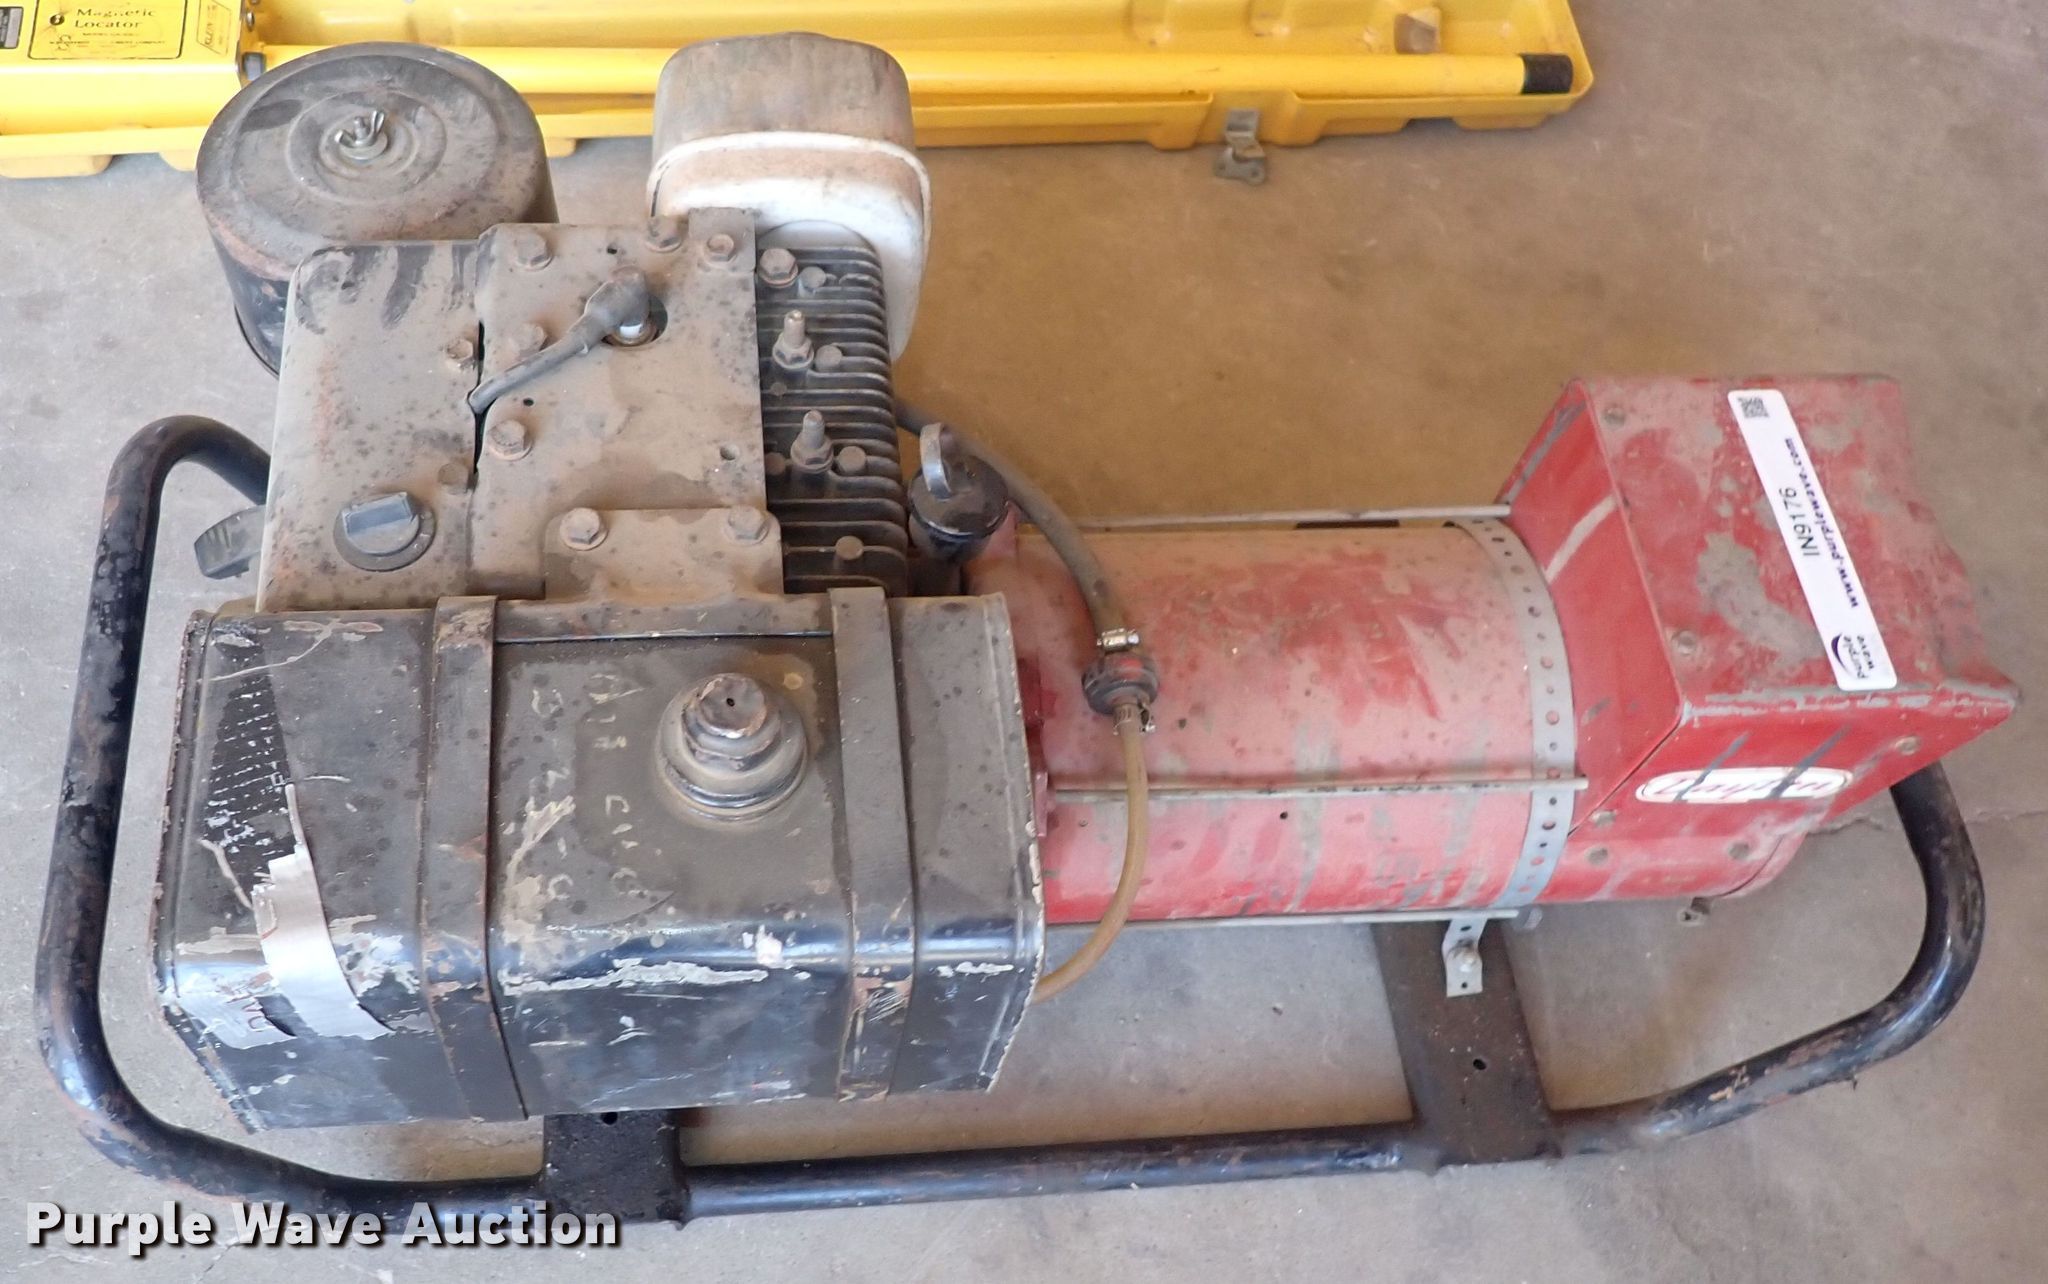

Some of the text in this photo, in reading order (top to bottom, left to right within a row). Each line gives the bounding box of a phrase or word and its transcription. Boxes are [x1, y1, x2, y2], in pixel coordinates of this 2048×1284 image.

[75, 19, 142, 28] Locator
[77, 8, 154, 18] Magnetic
[1778, 487, 1820, 557] IN9176
[1784, 437, 1859, 608] www.purplewave.com
[1842, 635, 1868, 679] purple
[1856, 634, 1875, 671] wave
